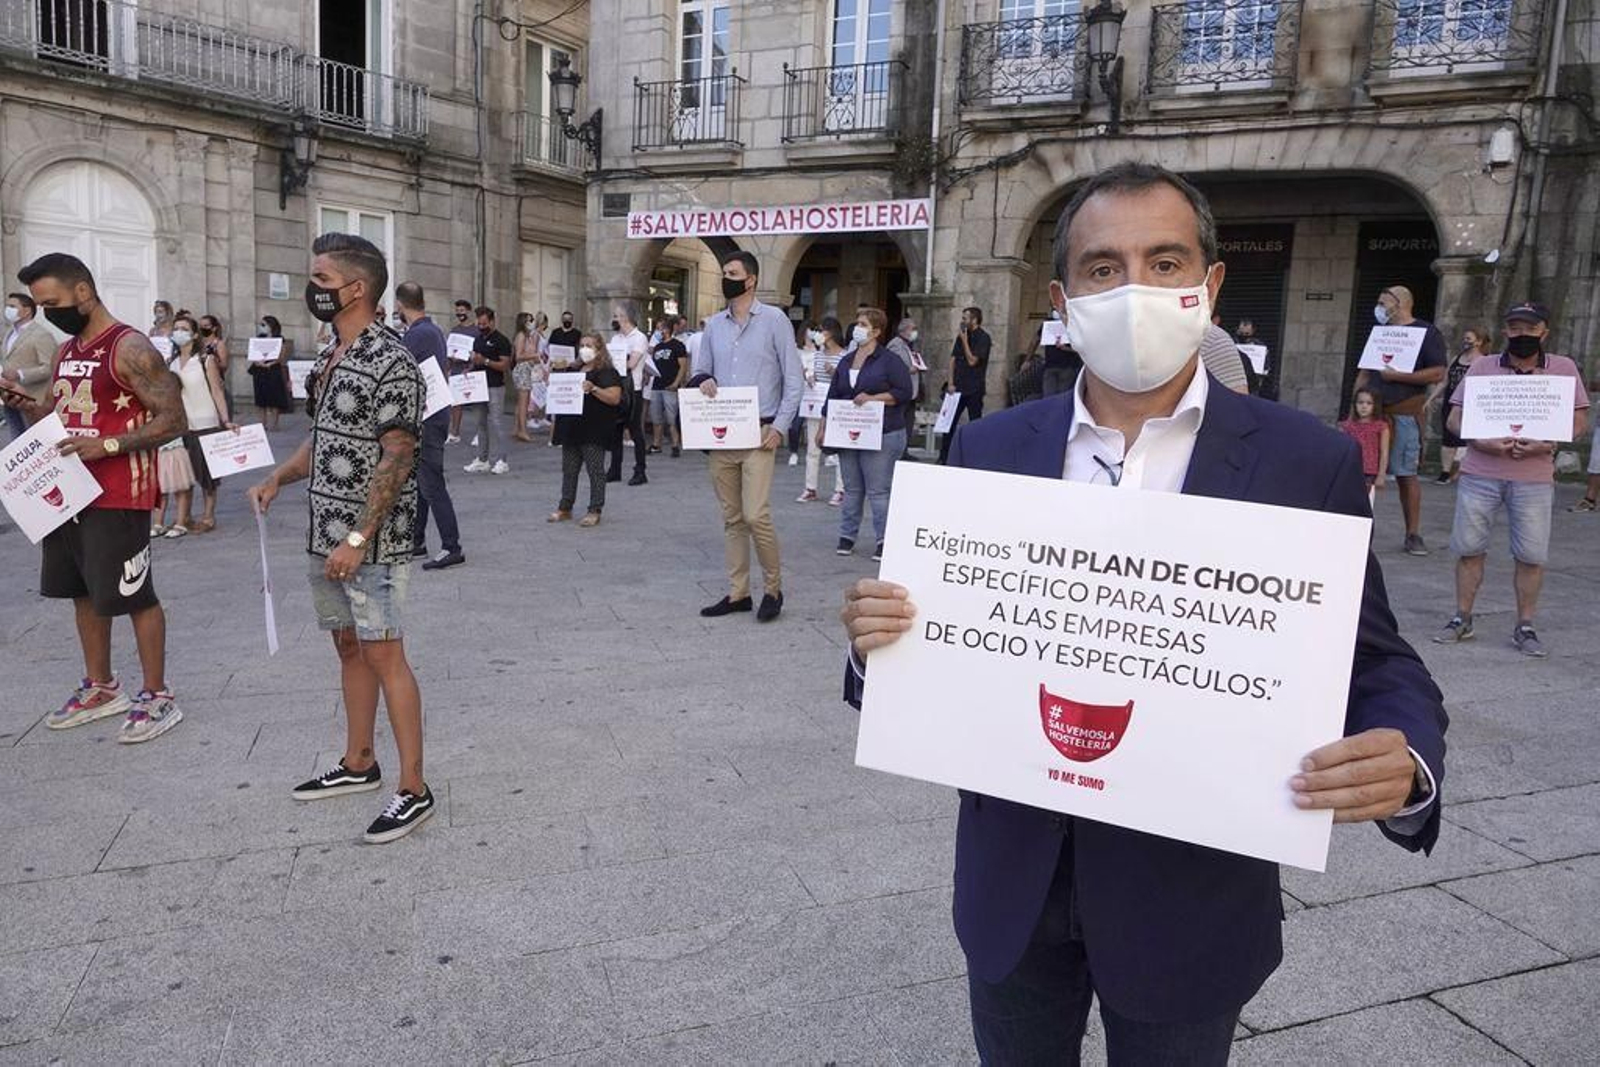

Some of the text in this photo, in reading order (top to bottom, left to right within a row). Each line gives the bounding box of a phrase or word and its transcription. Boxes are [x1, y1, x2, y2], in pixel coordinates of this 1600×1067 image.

[630, 203, 929, 235] #SALVEMOSLAHOSTELERIA
[59, 360, 102, 377] WEST
[53, 378, 99, 426] 24
[5, 439, 44, 473] LA CULPA
[3, 467, 34, 494] NUNCA
[23, 466, 63, 497] NUESTRA
[914, 527, 1012, 558] Exigimos
[1071, 549, 1145, 579] PLAN
[1151, 560, 1189, 585] DE
[1194, 567, 1324, 604] CHOQUE
[942, 563, 1277, 633] ESPECÍFICO PARA SALVAR
[925, 621, 957, 644] DE
[963, 627, 1028, 657] OCIO
[1034, 640, 1051, 661] Y
[988, 602, 1206, 655] A LAS EMPRESAS
[1048, 768, 1105, 791] YO ME SUMO
